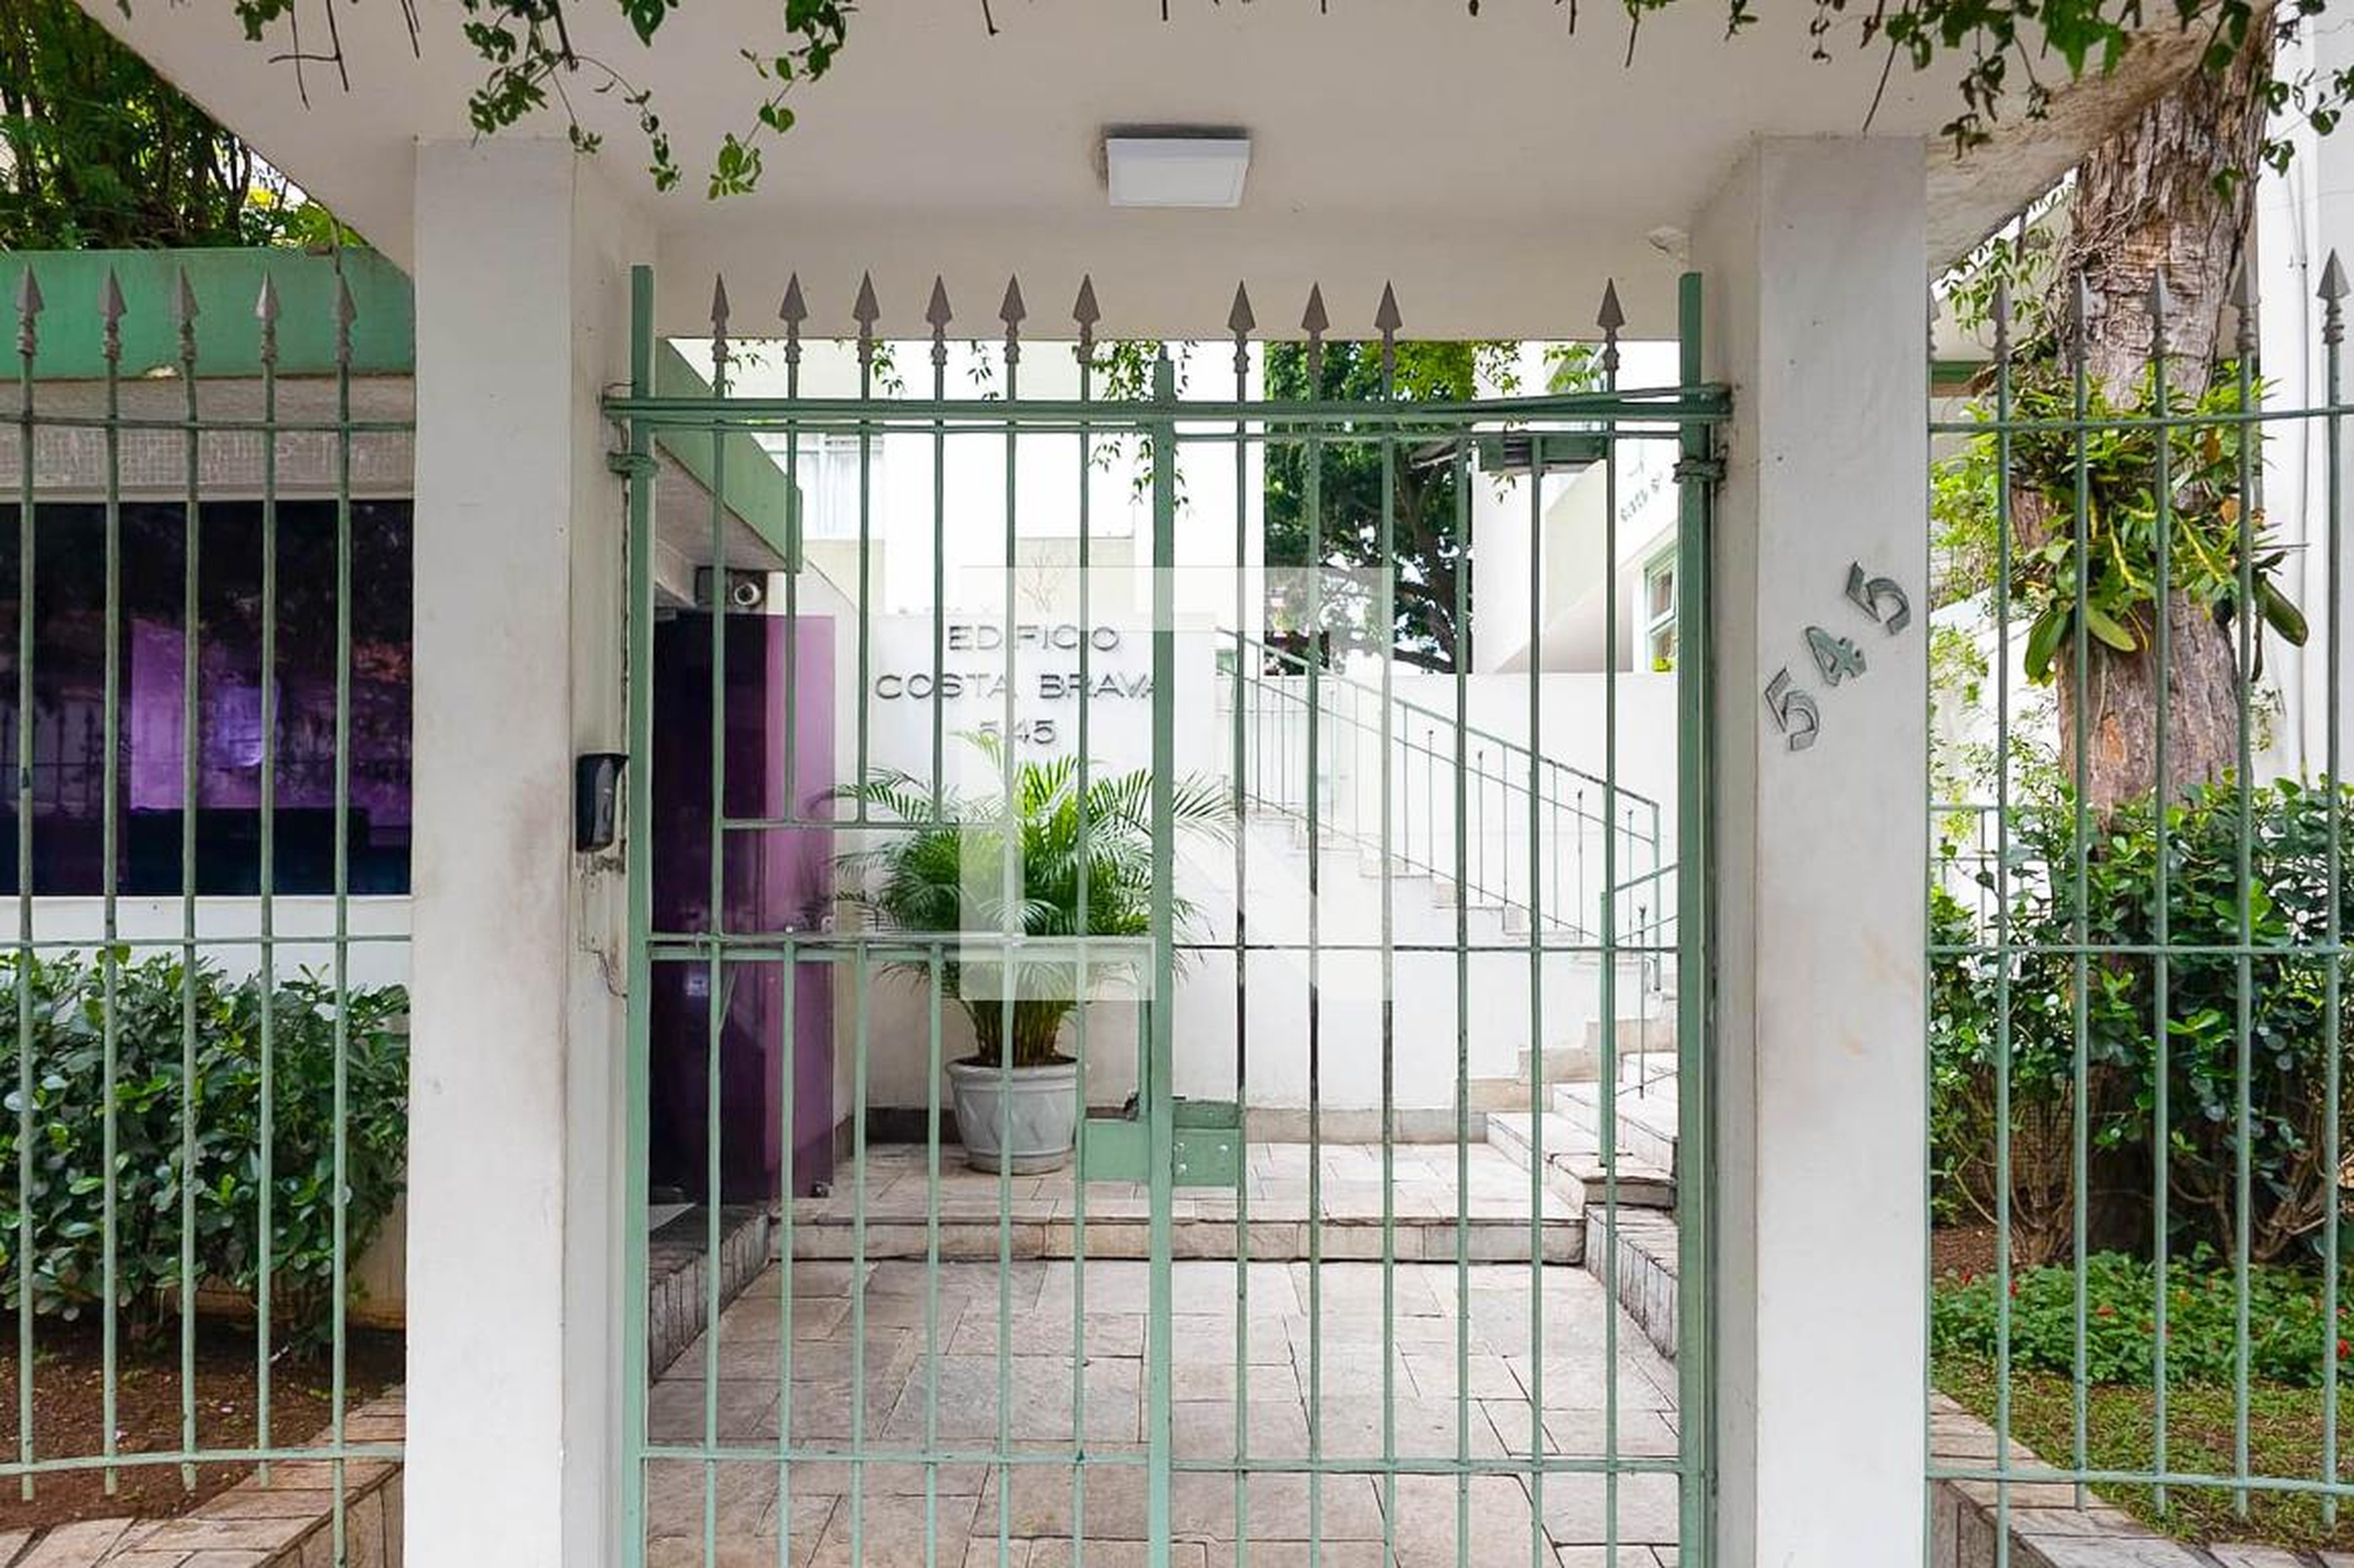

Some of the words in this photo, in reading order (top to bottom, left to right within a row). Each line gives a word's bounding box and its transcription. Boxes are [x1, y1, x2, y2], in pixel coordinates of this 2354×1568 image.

[949, 624, 1120, 652] EDFICO
[1764, 560, 1911, 752] 545
[876, 674, 1018, 699] COSTA
